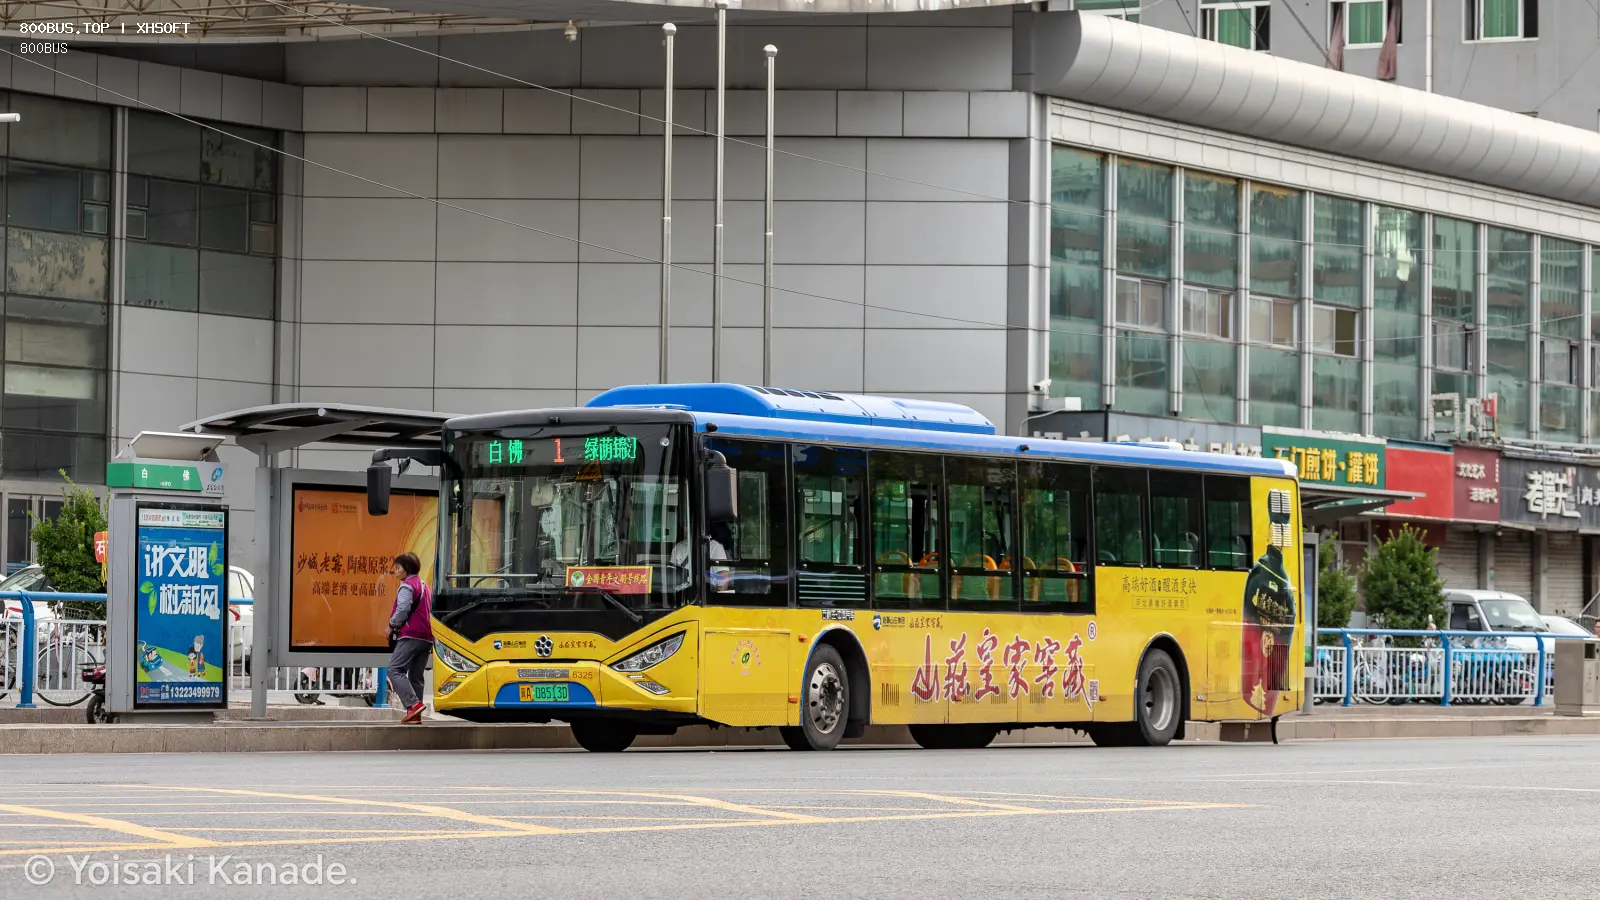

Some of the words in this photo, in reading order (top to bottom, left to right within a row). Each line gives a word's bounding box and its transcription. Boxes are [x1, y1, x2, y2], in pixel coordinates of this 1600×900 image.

[489, 440, 523, 464] 白佛
[553, 438, 565, 463] 1
[145, 544, 209, 578] 讲文明
[586, 573, 647, 585] 全国青年文明号线路
[313, 581, 347, 595] 高端老酒
[350, 583, 386, 597] 更高品位
[572, 671, 593, 679] 6325
[170, 686, 220, 698] 13223499979
